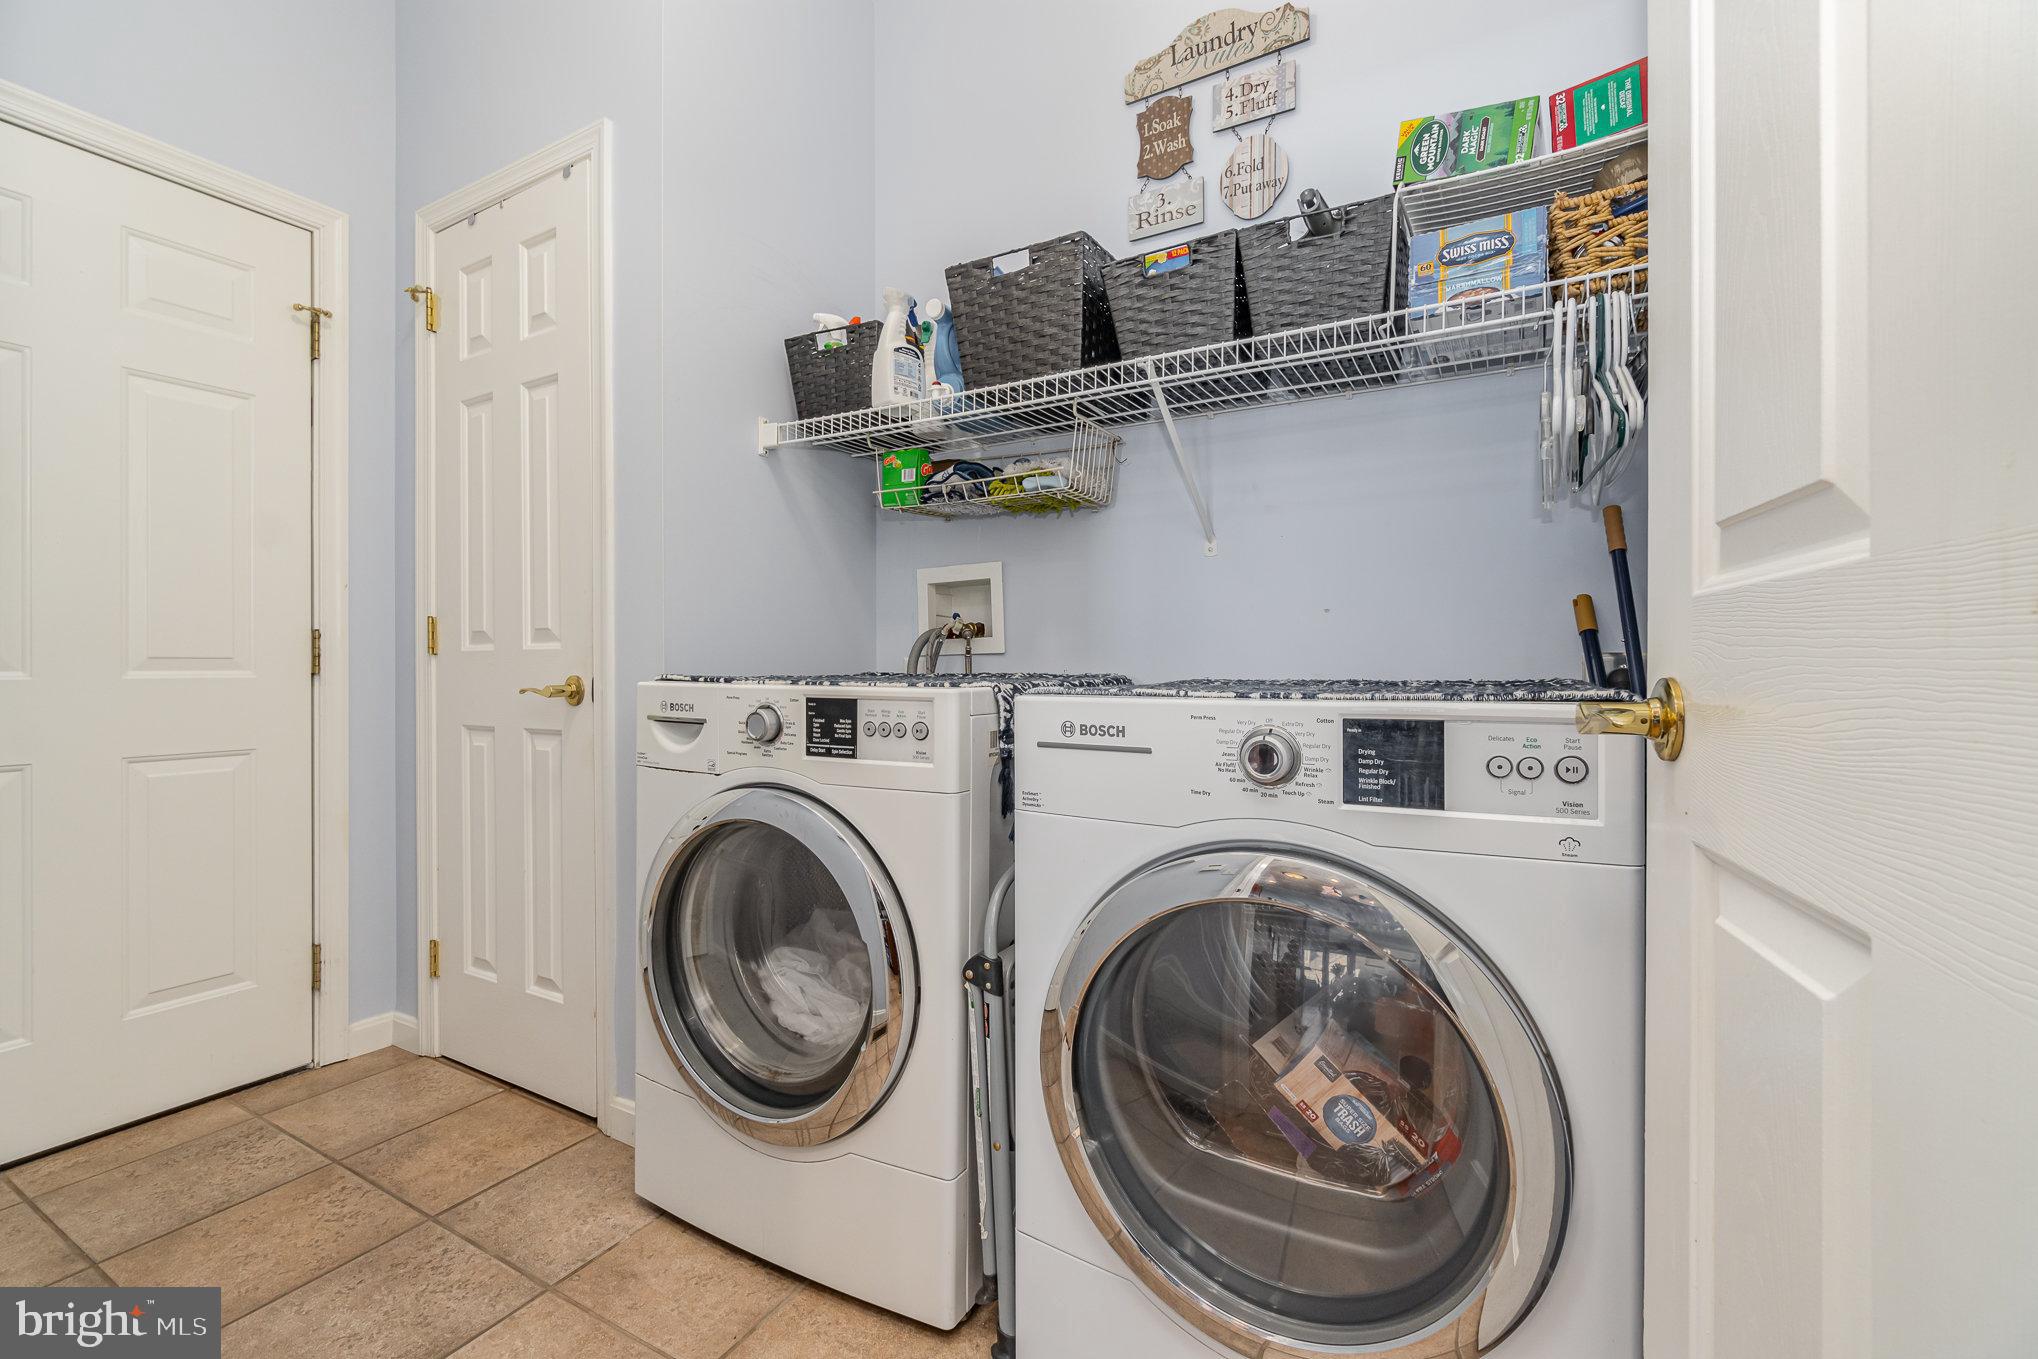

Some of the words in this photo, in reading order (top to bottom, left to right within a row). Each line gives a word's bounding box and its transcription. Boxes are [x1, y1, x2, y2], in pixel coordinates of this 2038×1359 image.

[1170, 20, 1259, 67] Laundry
[1426, 123, 1440, 171] MOUNTAIN
[1461, 129, 1471, 154] DARK
[1469, 125, 1479, 155] MAGIC
[1419, 133, 1431, 165] GREEN
[1255, 175, 1285, 192] away
[1156, 193, 1172, 209] 3.
[1135, 203, 1197, 231] Rinse
[1442, 243, 1477, 262] SWISS
[1479, 235, 1510, 252] MISS
[1420, 264, 1432, 272] 60
[1445, 275, 1504, 292] MARSHMALLOW
[670, 702, 694, 712] BOSCH
[1080, 724, 1126, 738] BOSCH
[1358, 748, 1376, 756] Drying
[1358, 767, 1378, 775] Regular
[1306, 1109, 1316, 1119] 20
[1334, 1102, 1366, 1137] TRASH
[1340, 1099, 1358, 1118] SUPER
[1358, 1118, 1371, 1131] SIZE
[1335, 1118, 1350, 1134] BAGS
[1411, 1132, 1425, 1148] 20
[1425, 1170, 1443, 1186] STRONG
